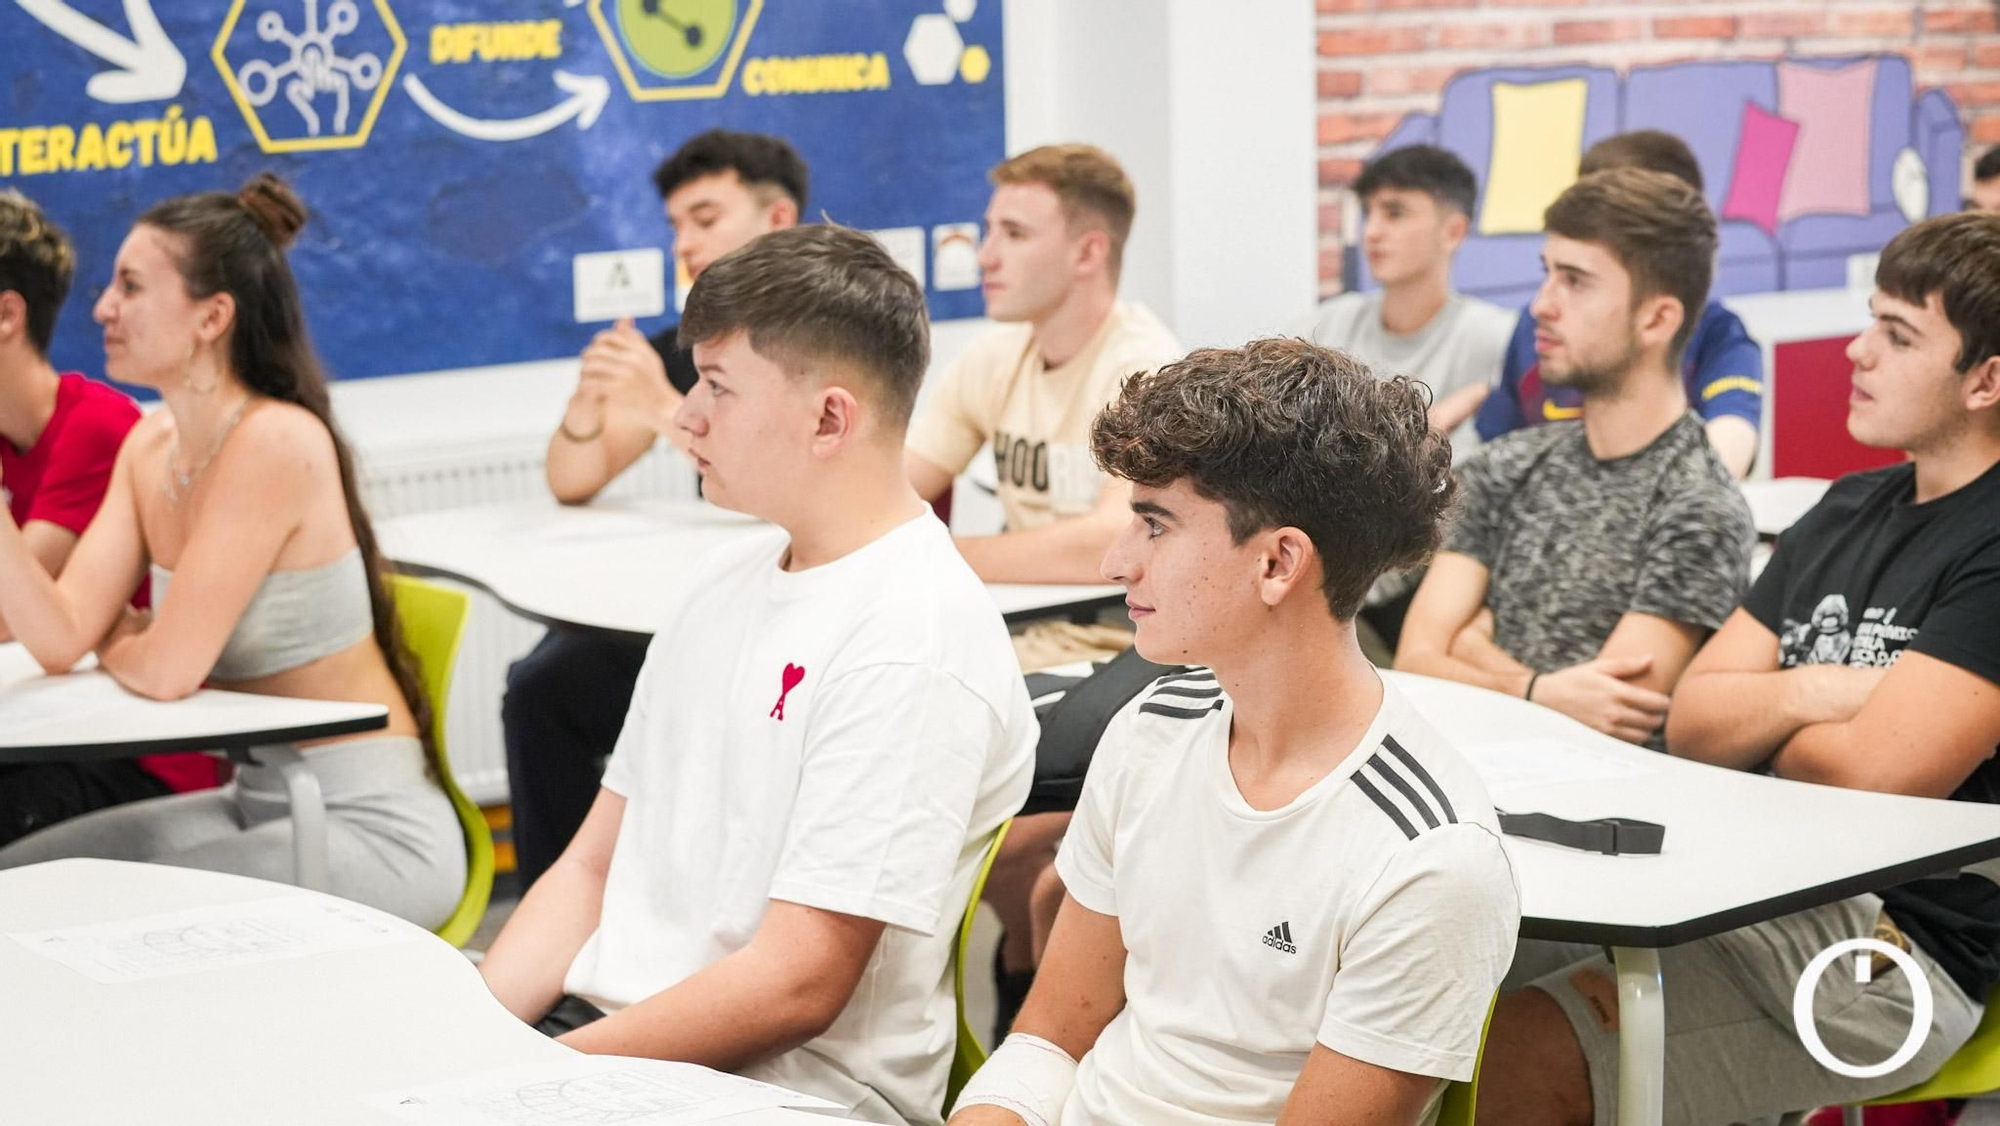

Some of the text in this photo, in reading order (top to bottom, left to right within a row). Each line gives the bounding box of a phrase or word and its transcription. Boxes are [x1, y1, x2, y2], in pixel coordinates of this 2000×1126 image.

[430, 19, 562, 63] DIFUNDE
[741, 51, 890, 95] COMUNICA
[1262, 935, 1297, 954] adidas
